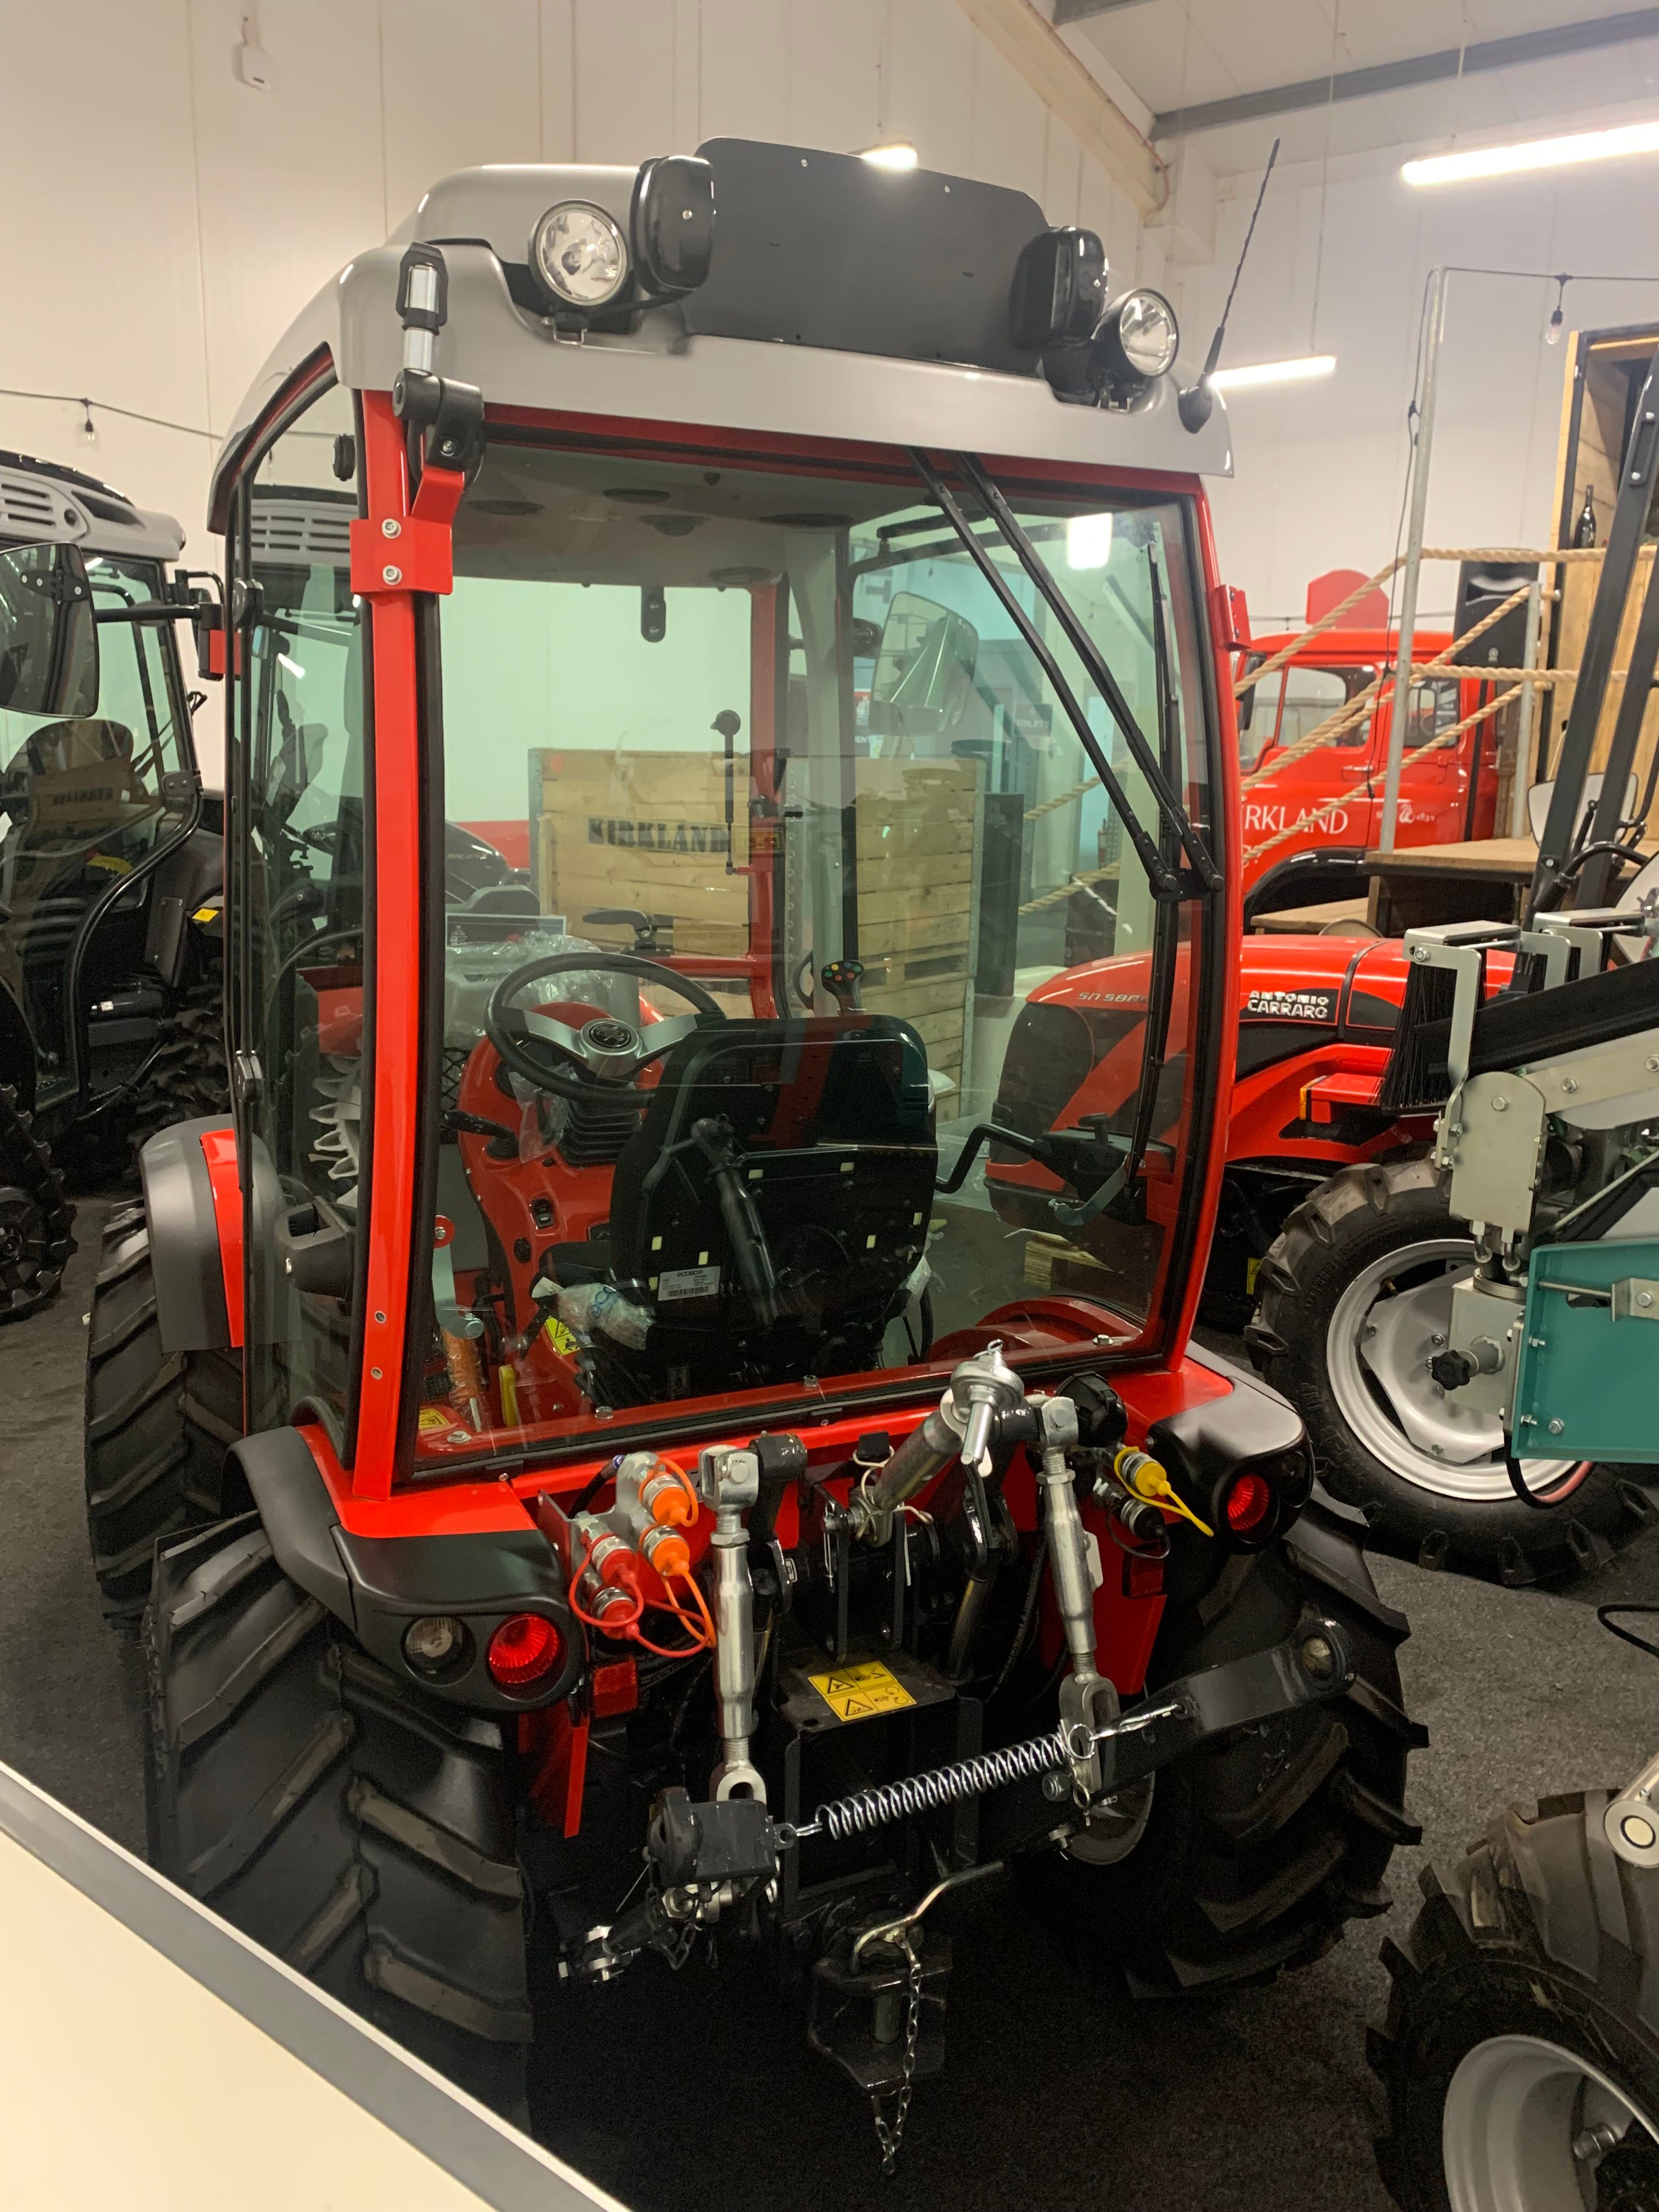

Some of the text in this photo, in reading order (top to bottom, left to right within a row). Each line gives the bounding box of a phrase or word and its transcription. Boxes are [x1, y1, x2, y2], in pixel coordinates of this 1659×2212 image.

[1242, 805, 1348, 834] RKLAND
[1249, 990, 1329, 1006] ANTONIO
[1247, 999, 1328, 1019] CARRARO
